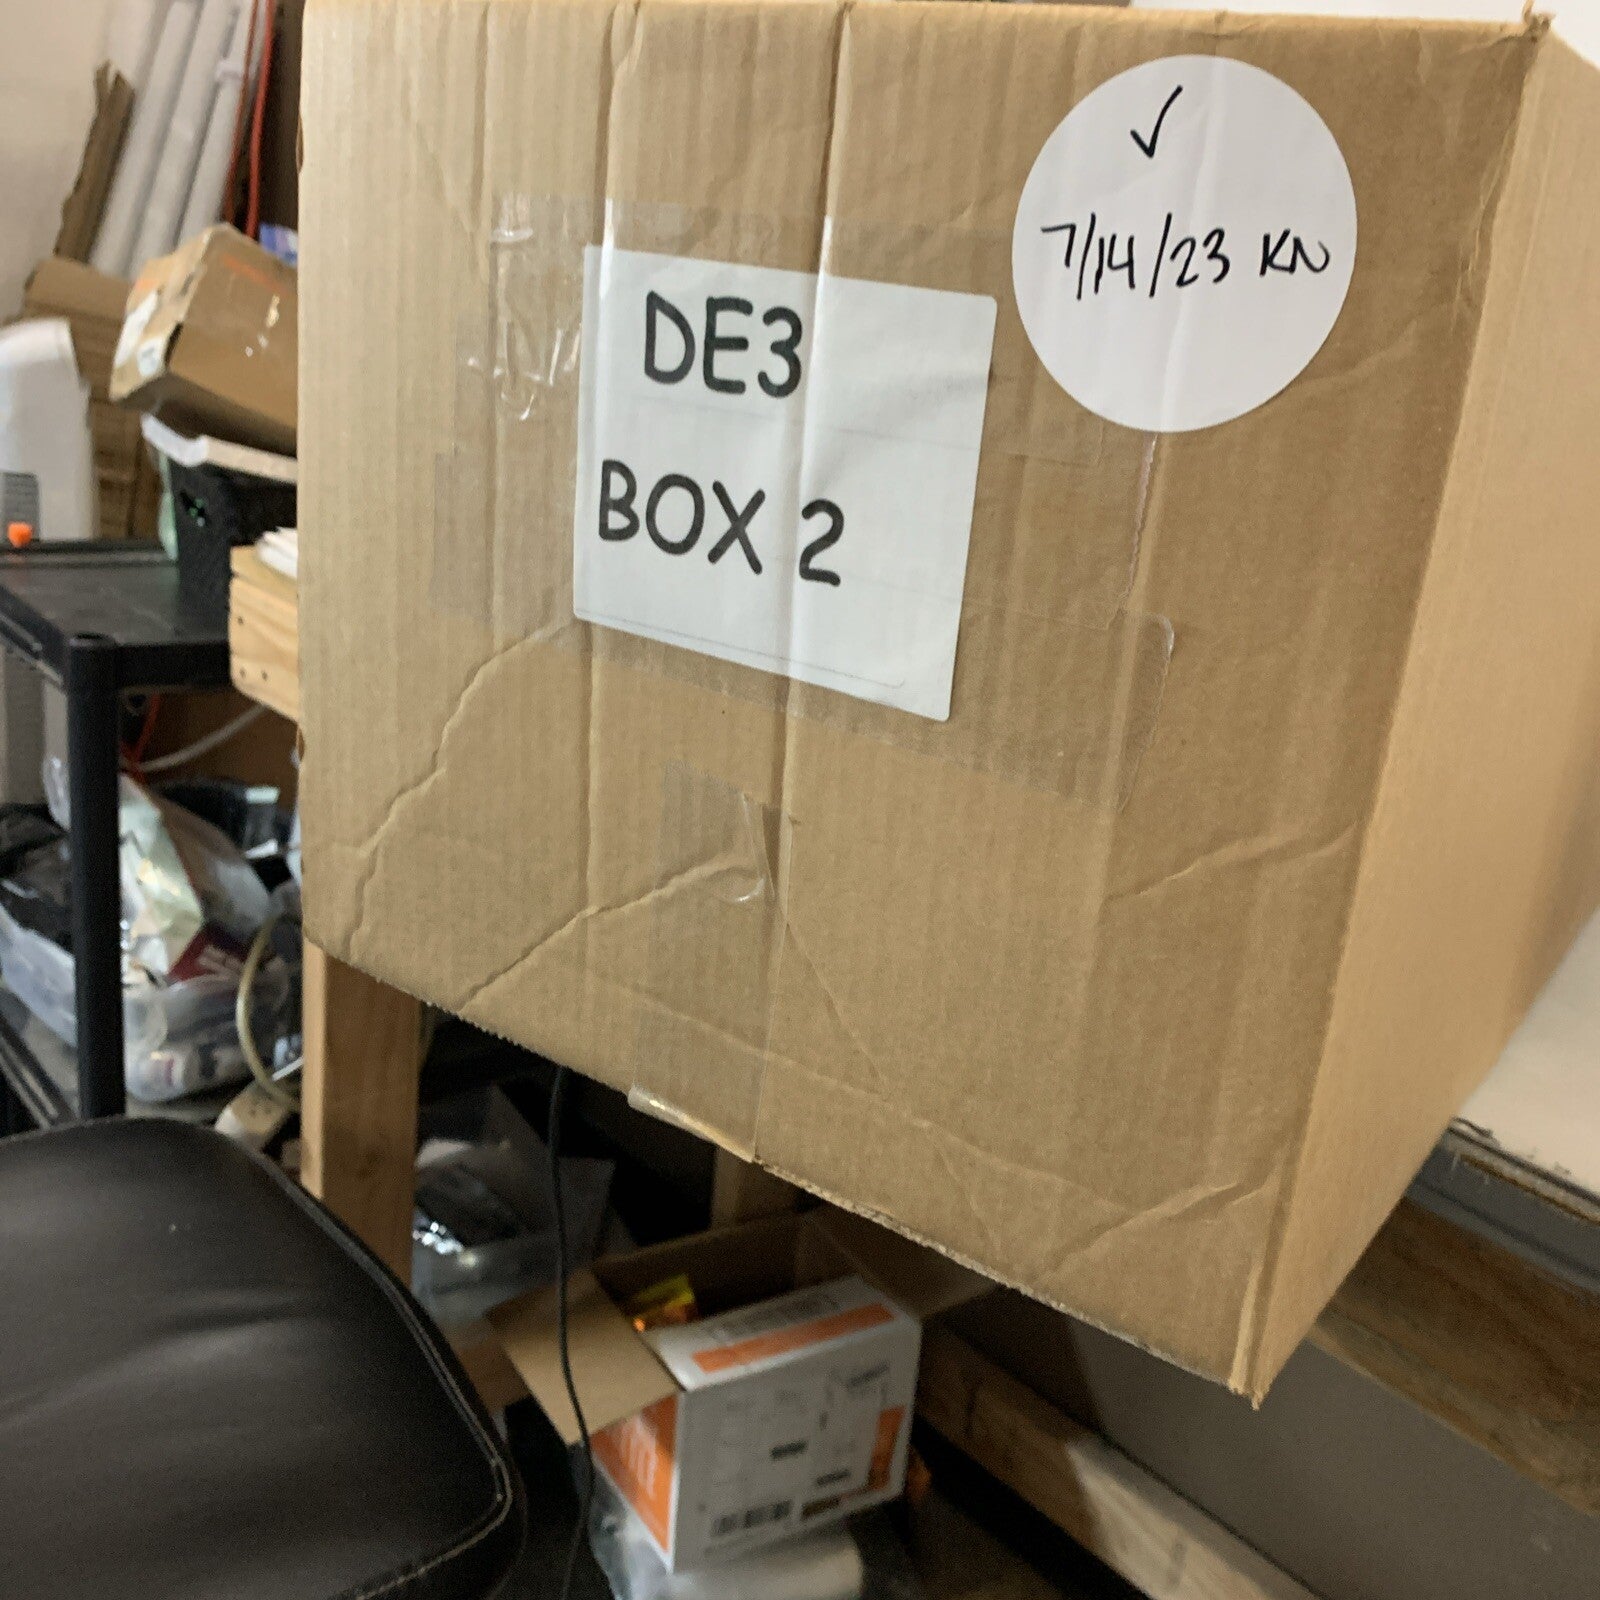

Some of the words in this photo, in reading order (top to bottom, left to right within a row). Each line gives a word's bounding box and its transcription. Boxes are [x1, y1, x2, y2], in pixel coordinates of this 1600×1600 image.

[1041, 212, 1231, 301] 7/14/23
[1259, 229, 1331, 277] KN
[644, 290, 803, 398] DE3
[599, 459, 766, 575] BOX
[799, 498, 845, 587] 2
